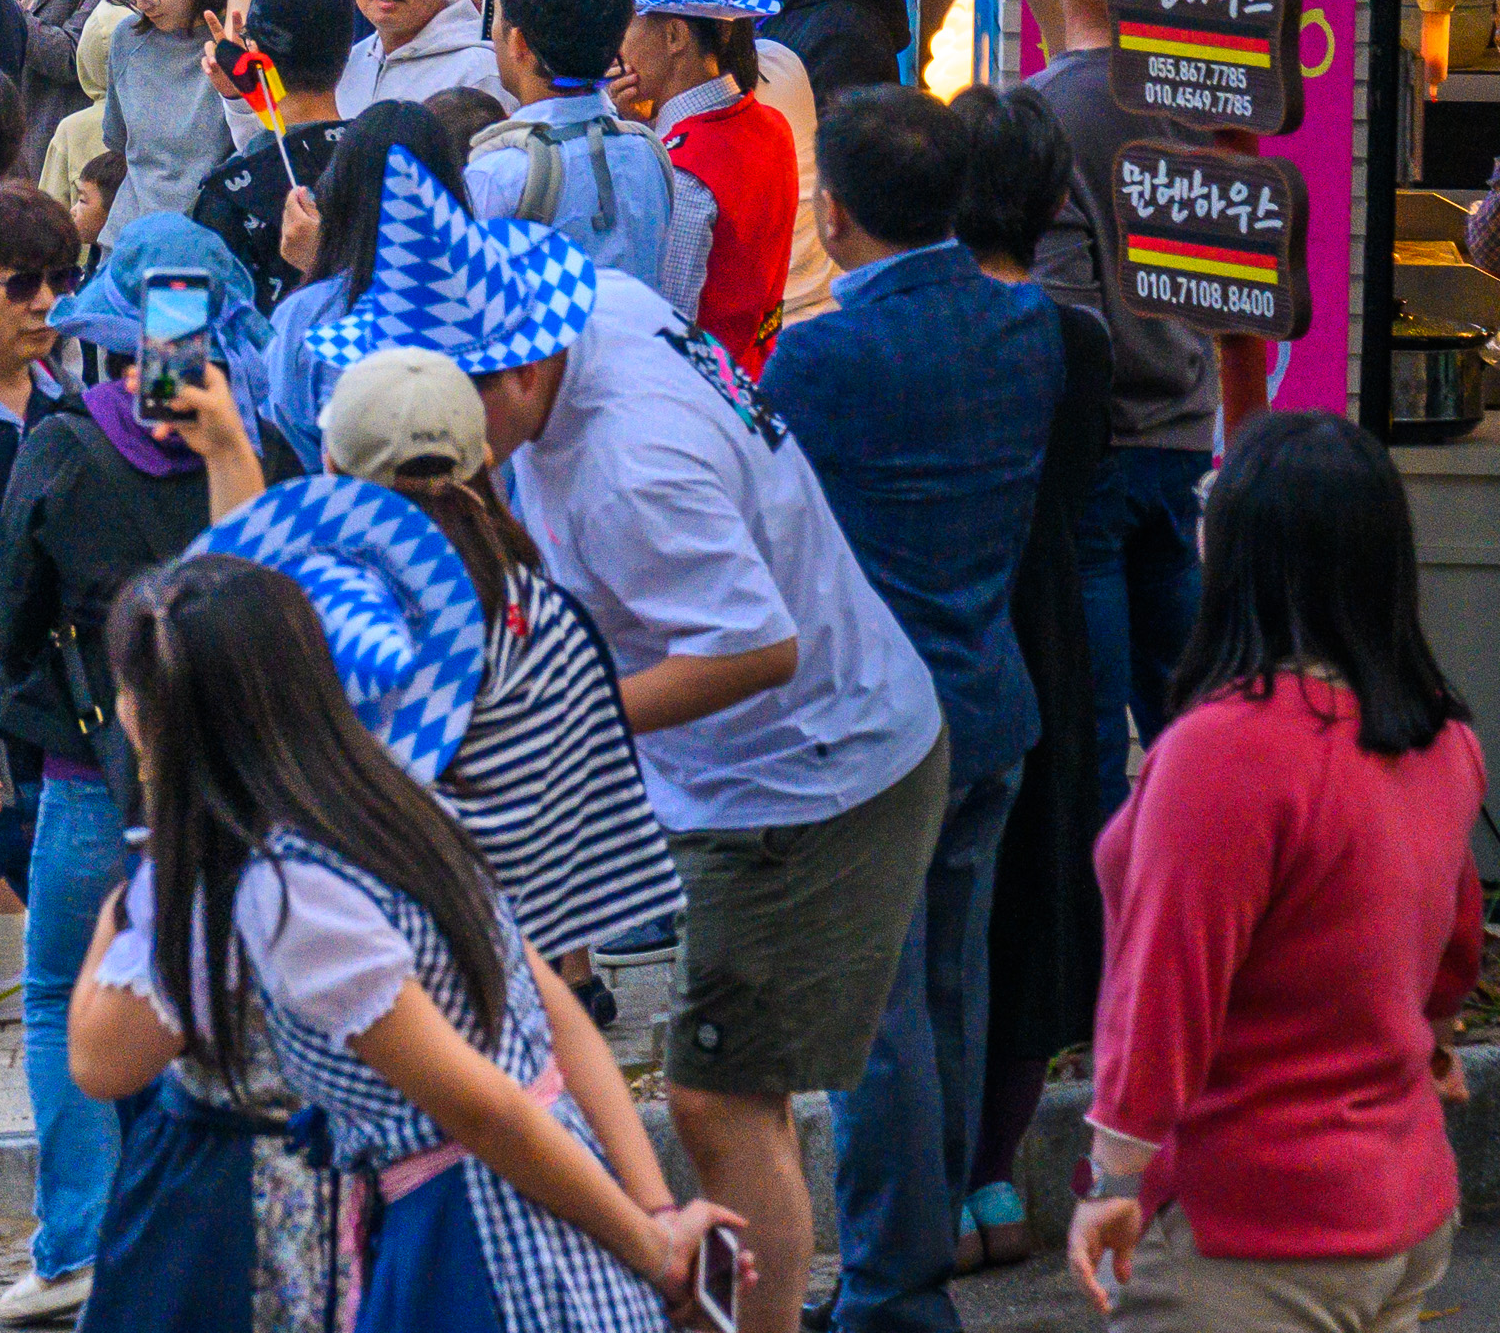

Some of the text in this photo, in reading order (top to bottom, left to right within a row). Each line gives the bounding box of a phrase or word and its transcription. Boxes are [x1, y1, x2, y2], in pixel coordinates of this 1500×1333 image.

[1147, 56, 1248, 89] 055.867.7785
[1144, 80, 1253, 118] 010.4549.7785
[1121, 159, 1284, 234] 뮌헨하우스
[1136, 270, 1274, 320] 010.7108.8400
